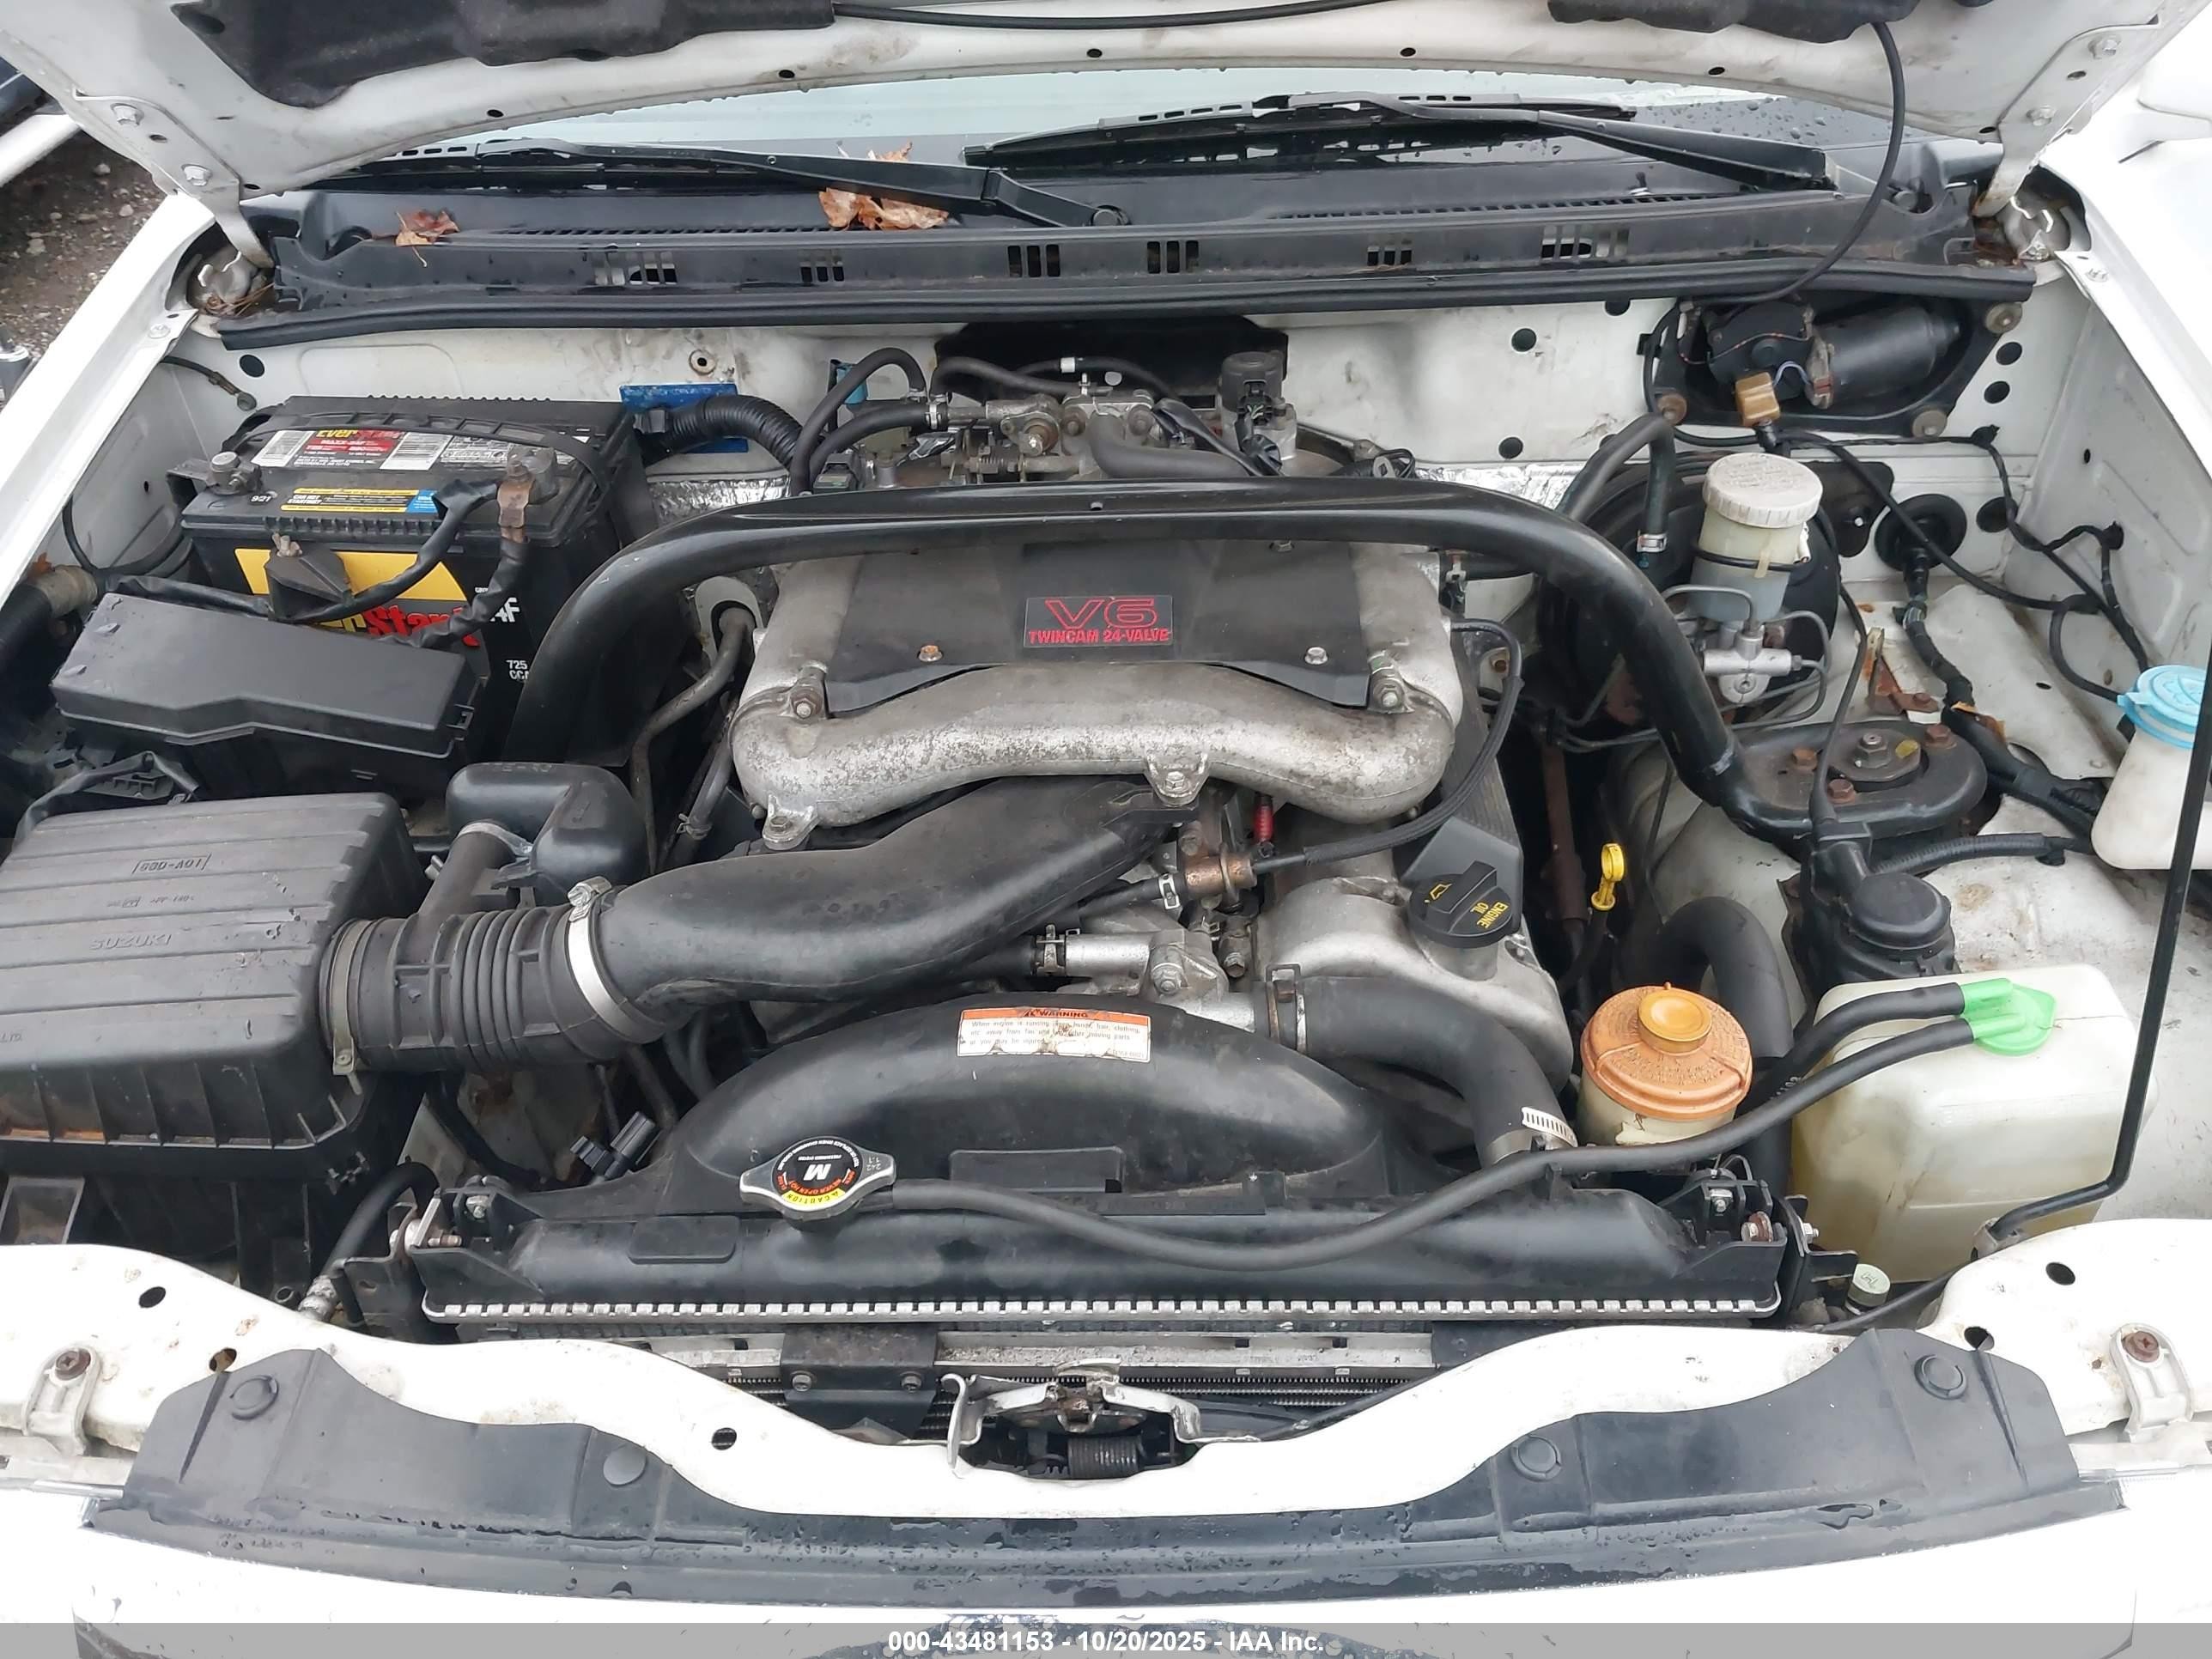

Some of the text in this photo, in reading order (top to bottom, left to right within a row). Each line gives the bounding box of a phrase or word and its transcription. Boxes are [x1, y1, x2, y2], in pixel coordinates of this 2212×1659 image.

[1044, 598, 1158, 629] V6
[1029, 627, 1170, 645] TWINCAM 24-VALVE
[506, 659, 528, 670] 725
[1470, 902, 1489, 914] OIL
[1476, 902, 1509, 928] ENGINE
[89, 933, 172, 950] SUZUKI
[1039, 1010, 1089, 1018] WARNING
[803, 1164, 832, 1181] M
[787, 1194, 830, 1205] CAUTION
